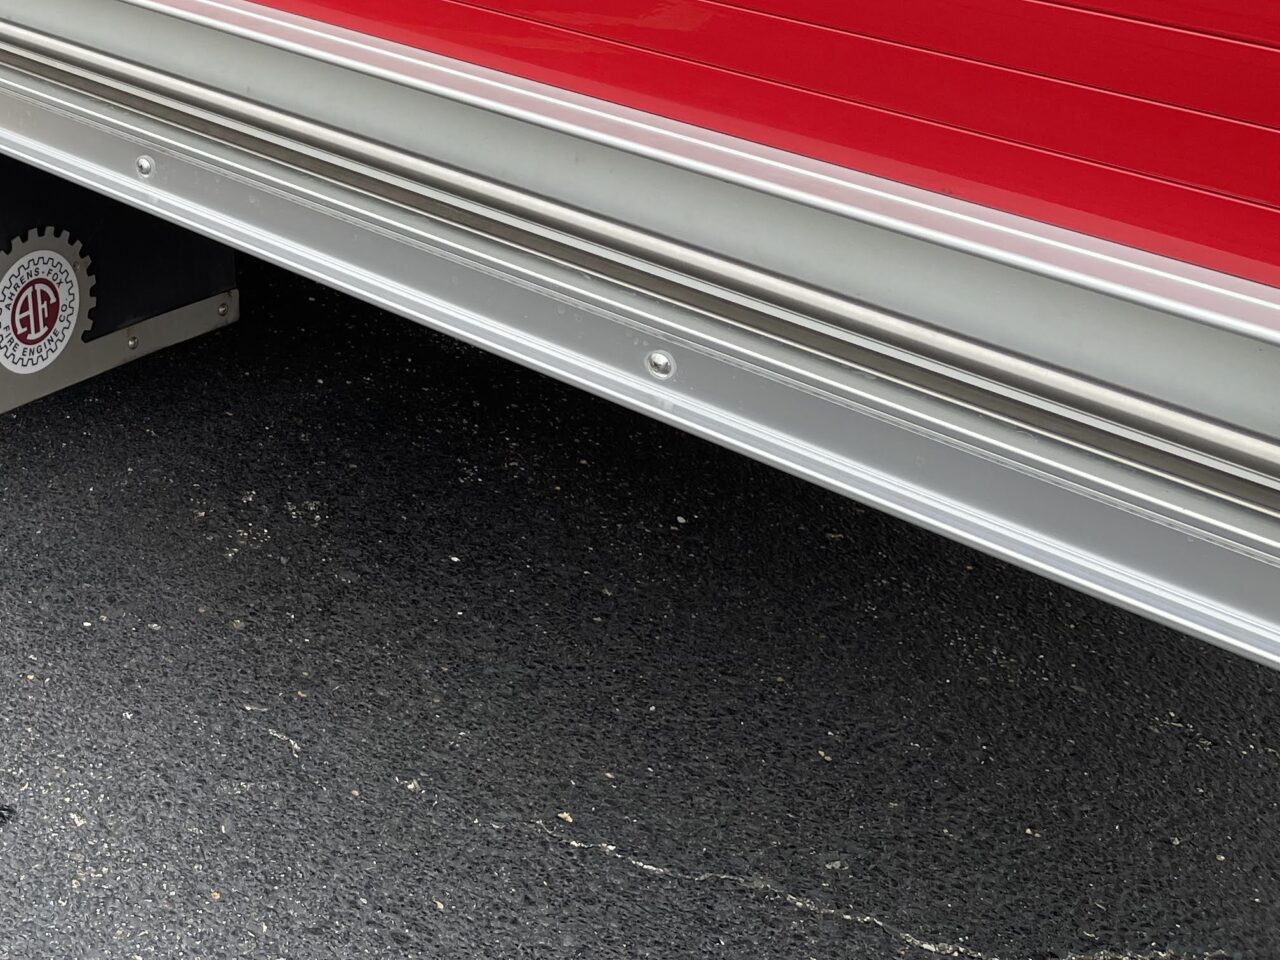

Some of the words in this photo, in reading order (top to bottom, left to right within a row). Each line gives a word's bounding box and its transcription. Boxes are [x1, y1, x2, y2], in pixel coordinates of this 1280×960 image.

[5, 267, 64, 311] AHRENS-FOX
[3, 324, 20, 352] FIRE
[21, 328, 60, 357] ENGINE
